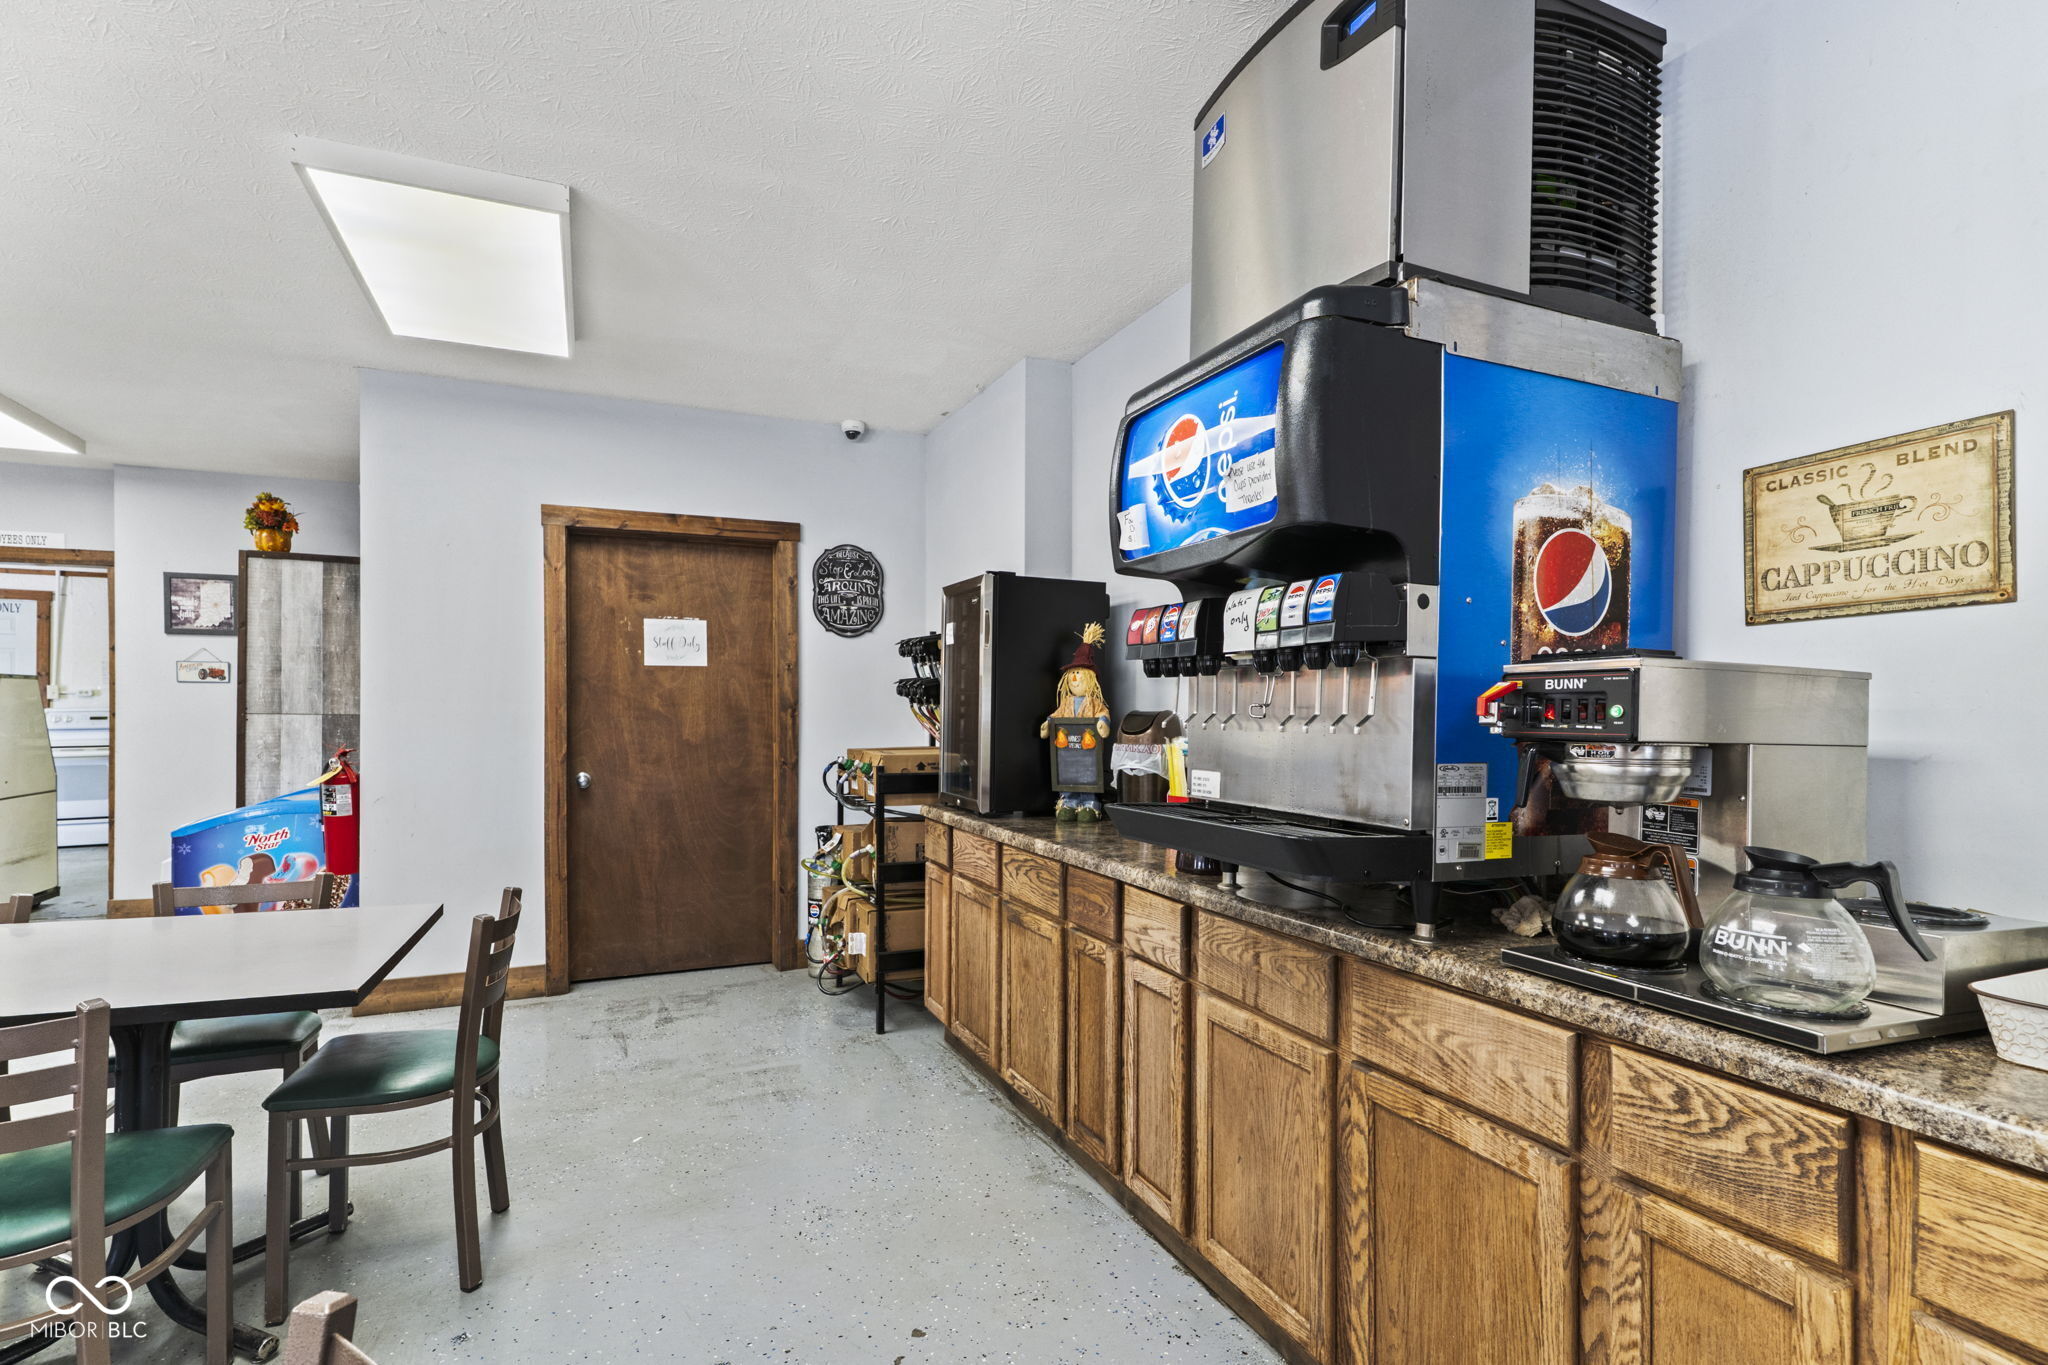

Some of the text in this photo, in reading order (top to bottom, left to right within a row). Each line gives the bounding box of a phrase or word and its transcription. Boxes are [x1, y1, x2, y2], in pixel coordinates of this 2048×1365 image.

[1766, 438, 1978, 492] CLASSIC BLEND
[0, 534, 47, 546] YEES ONLY
[819, 561, 879, 579] Stop & Look
[1760, 540, 1989, 592] CAPPUCCINO
[821, 581, 876, 595] AROUND
[1315, 587, 1333, 595] PEPSI
[1884, 582, 1896, 591] the
[1903, 578, 1928, 589] Hot
[1937, 575, 1965, 588] Days
[0, 602, 21, 613] NLY
[821, 608, 876, 625] AMAZING
[1230, 611, 1249, 632] only
[653, 637, 674, 650] Staff
[1545, 678, 1584, 690] BUNN
[244, 828, 290, 847] North
[255, 841, 280, 852] Star
[1714, 929, 1787, 958] BUNN
